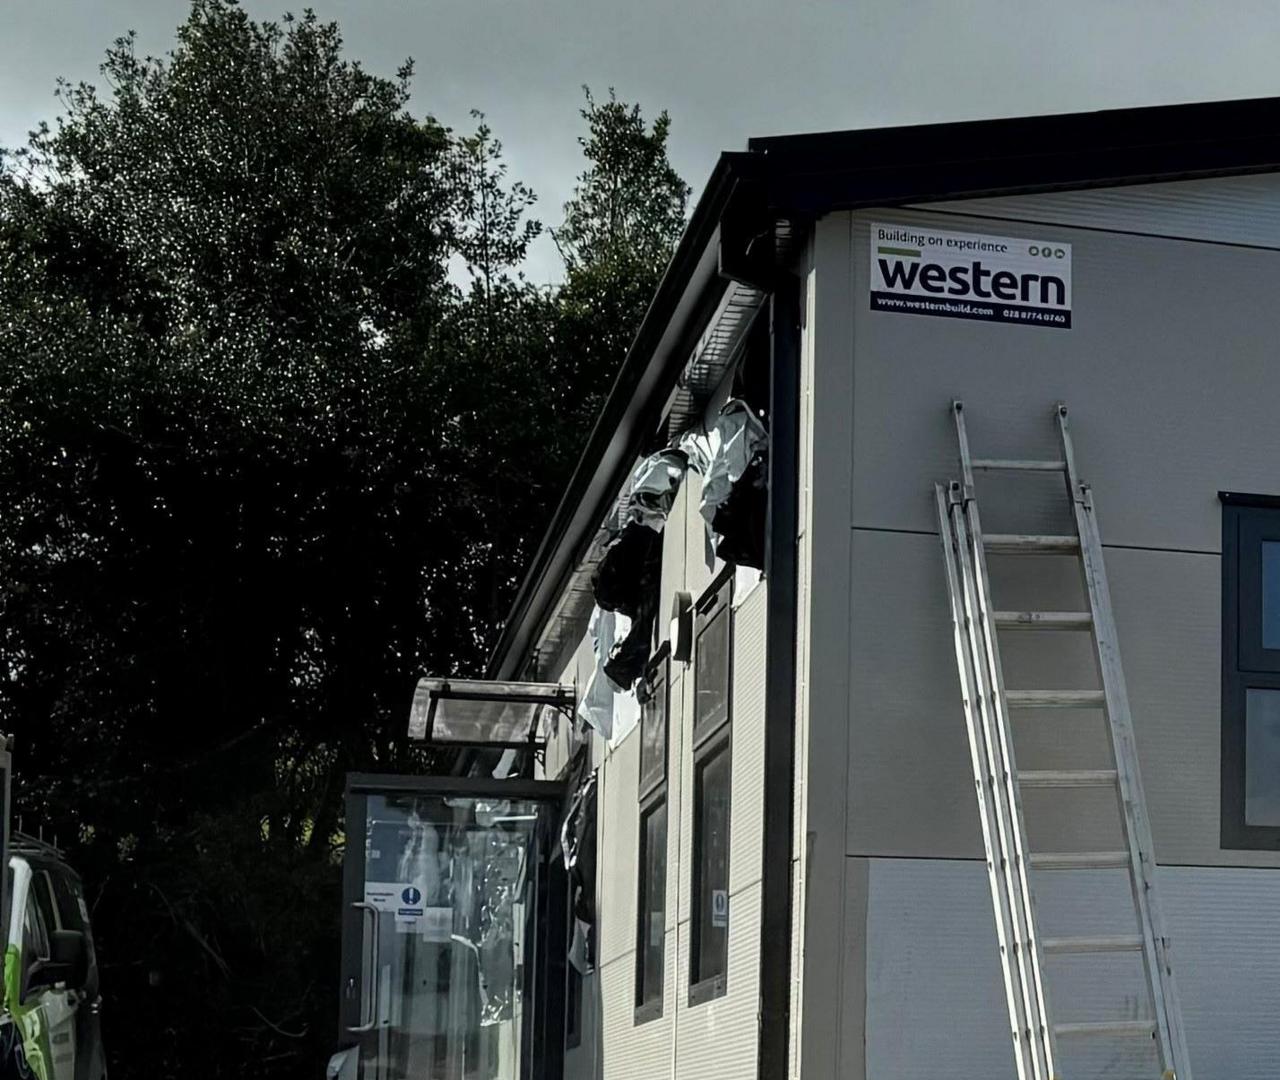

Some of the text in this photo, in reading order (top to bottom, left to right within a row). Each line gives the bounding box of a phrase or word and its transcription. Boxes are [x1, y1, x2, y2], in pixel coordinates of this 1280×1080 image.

[878, 229, 1008, 253] Building on experience
[878, 258, 1066, 306] western
[877, 298, 994, 316] www.westernbuild.com
